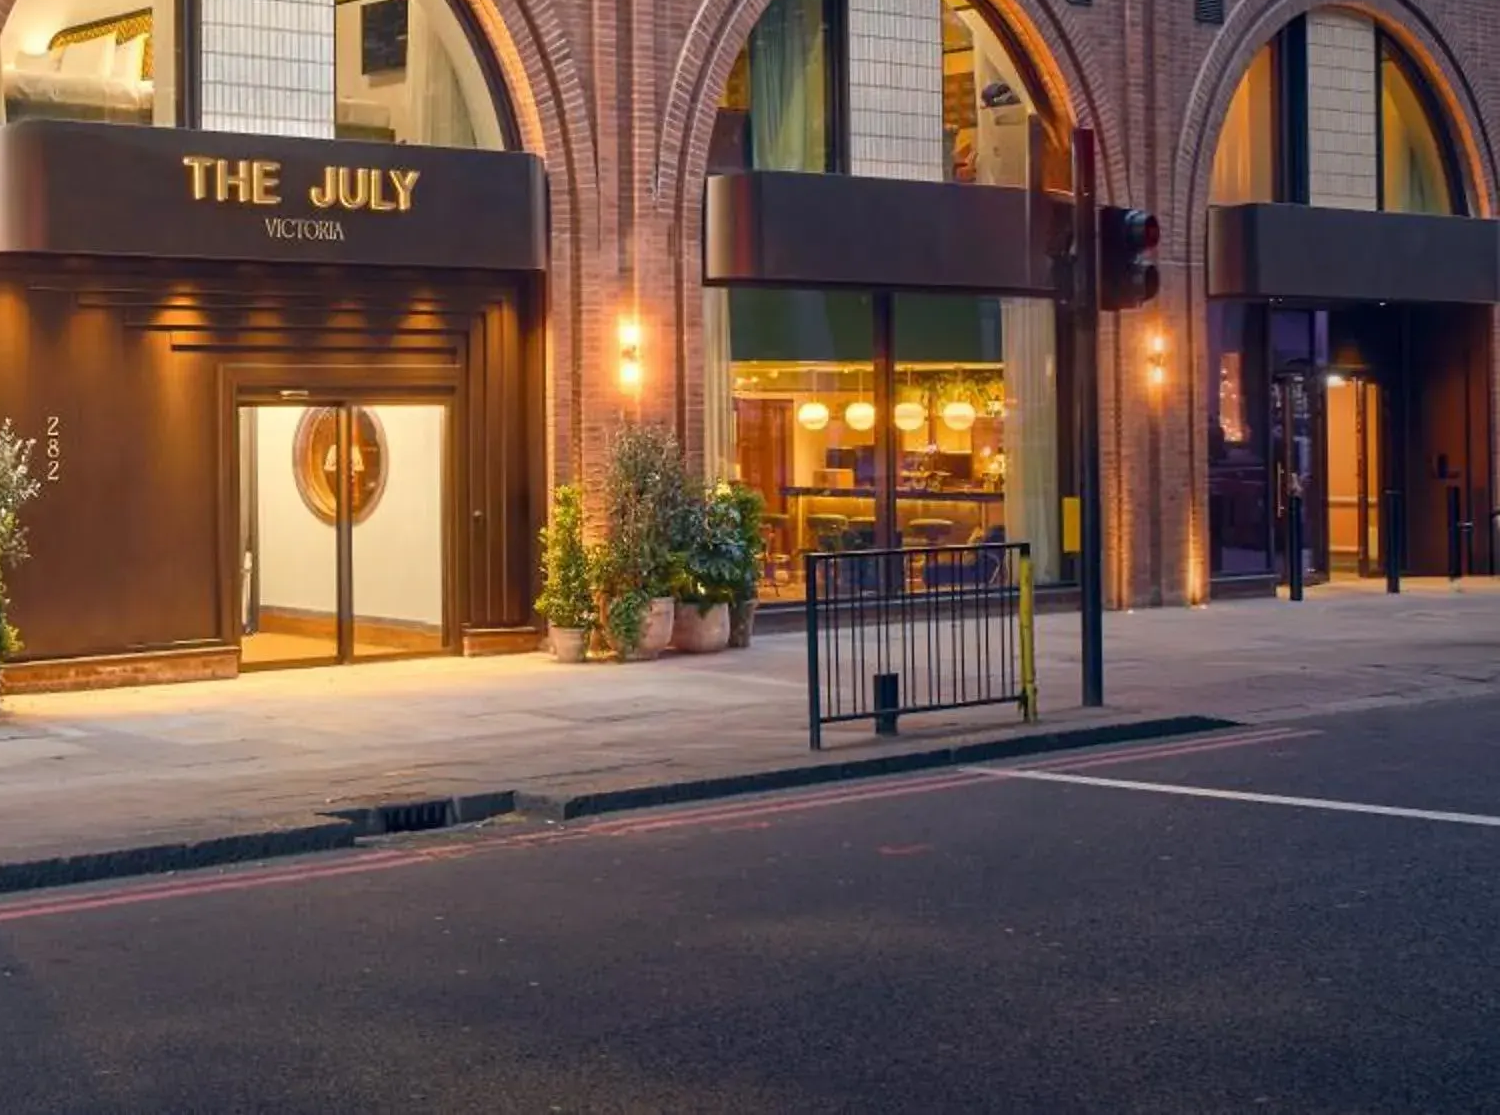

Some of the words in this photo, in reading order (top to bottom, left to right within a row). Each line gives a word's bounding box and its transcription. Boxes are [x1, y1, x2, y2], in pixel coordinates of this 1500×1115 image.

[182, 155, 282, 205] THE
[309, 165, 421, 211] JULY
[264, 218, 345, 241] VICTORIA
[47, 416, 60, 481] 282
